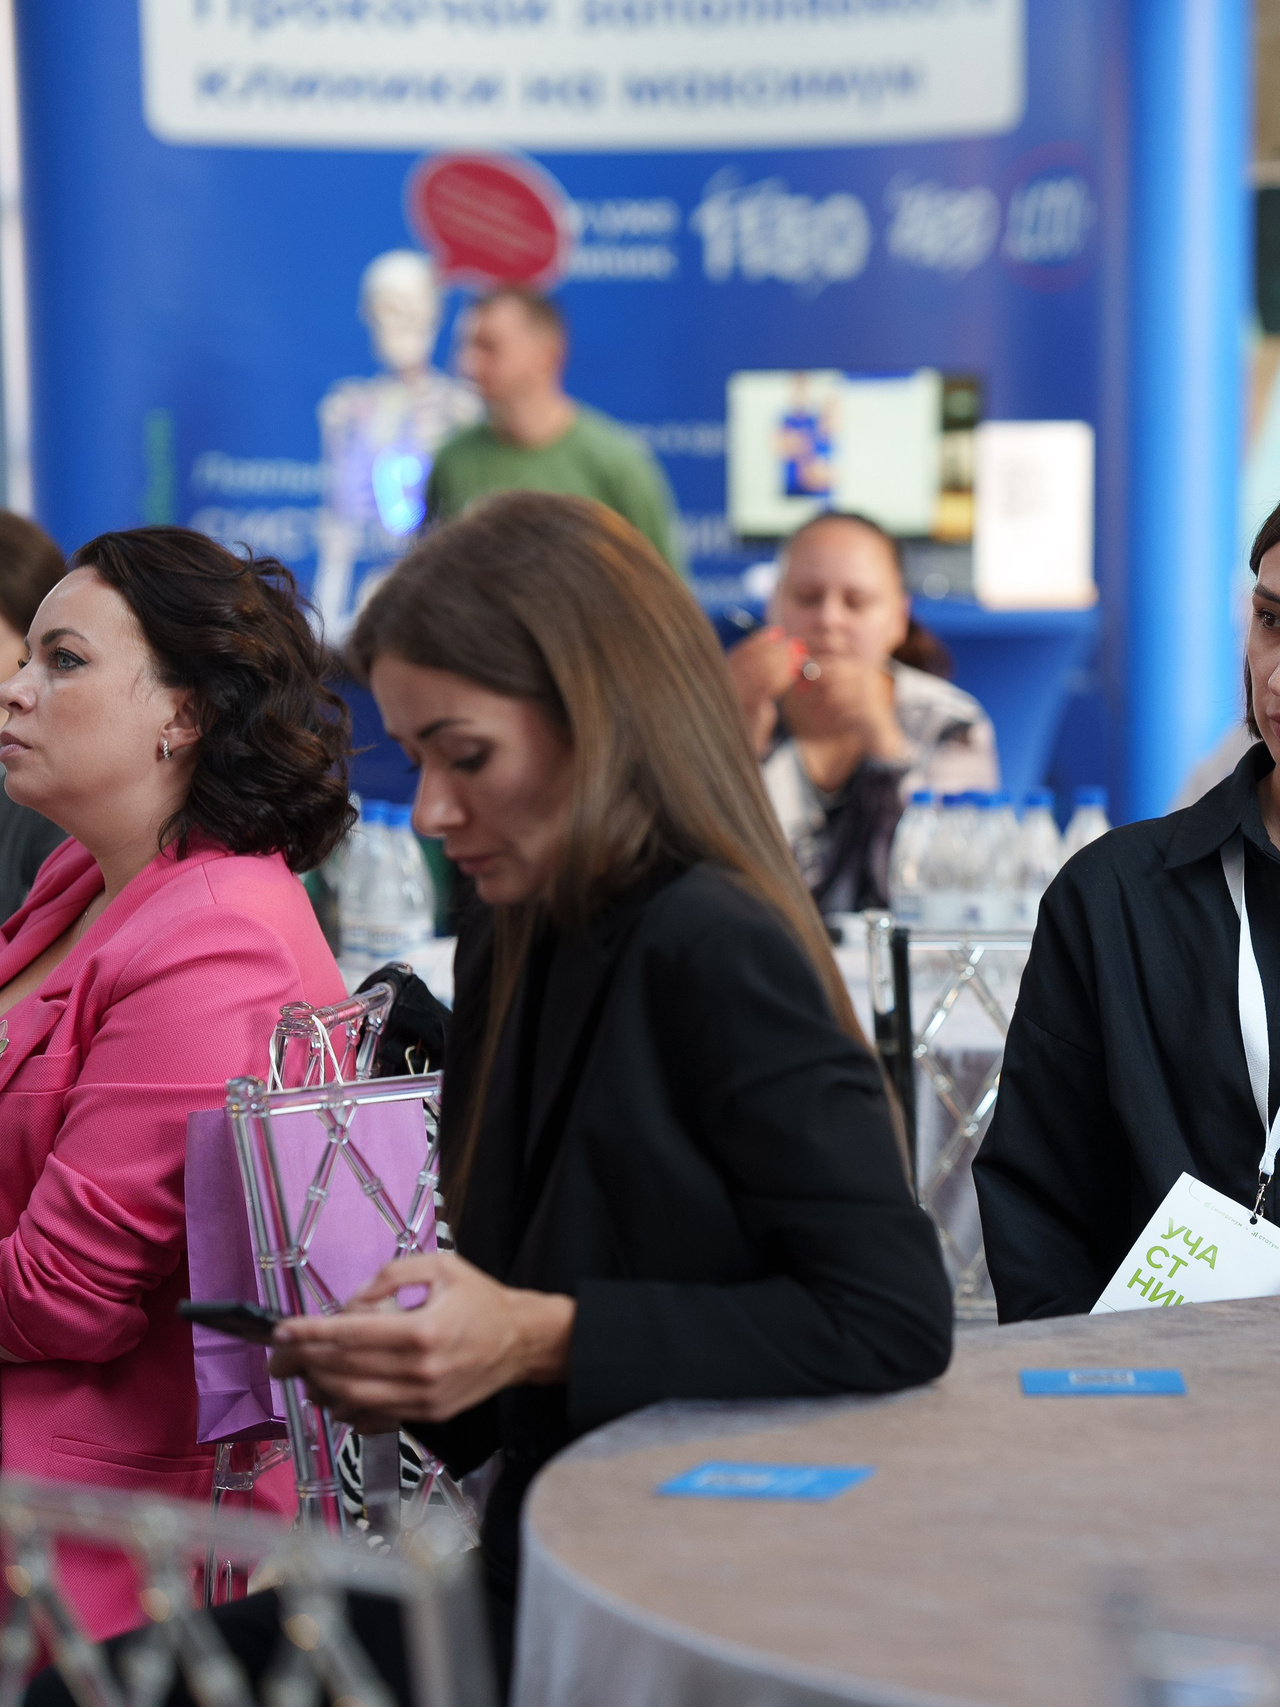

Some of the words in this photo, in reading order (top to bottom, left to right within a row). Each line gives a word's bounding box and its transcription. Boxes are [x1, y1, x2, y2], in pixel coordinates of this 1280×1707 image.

[1145, 1244, 1189, 1279] СТ
[1160, 1216, 1219, 1270] УЧА
[1126, 1267, 1195, 1308] НИ
